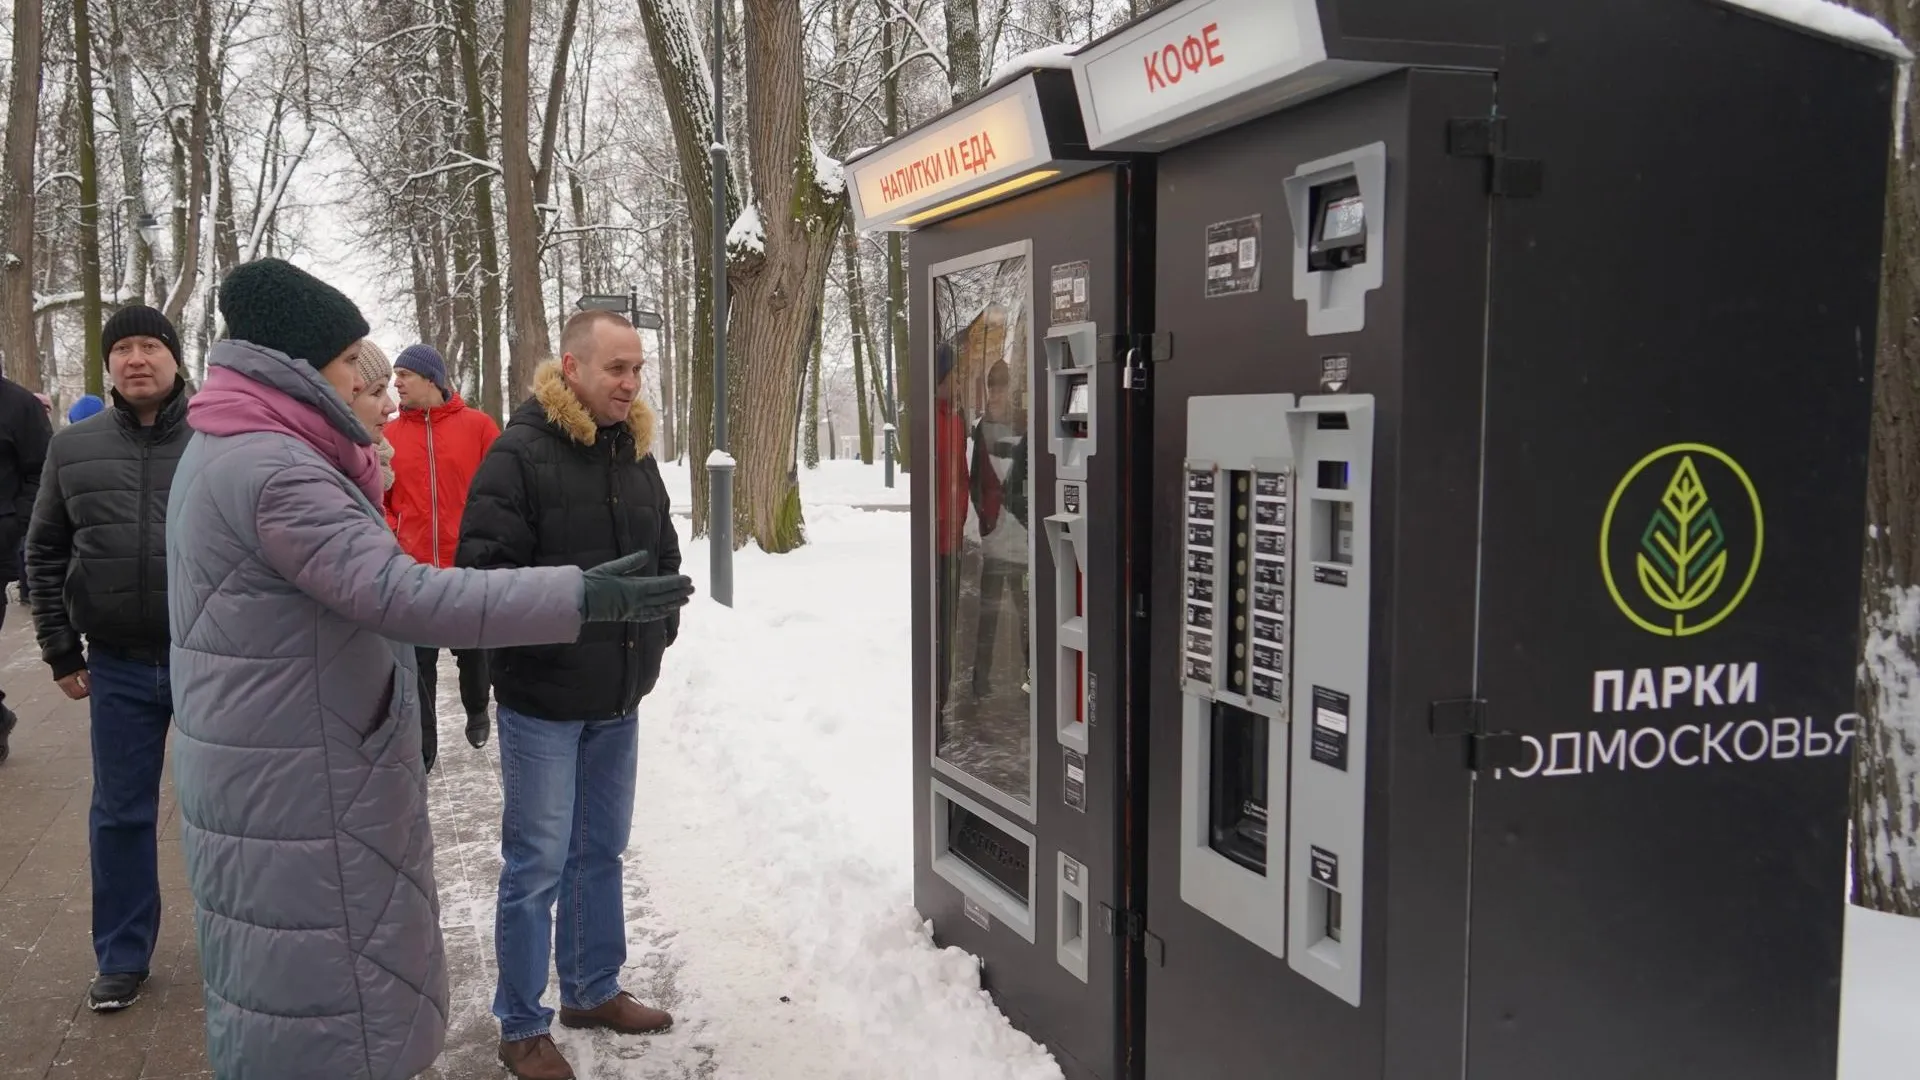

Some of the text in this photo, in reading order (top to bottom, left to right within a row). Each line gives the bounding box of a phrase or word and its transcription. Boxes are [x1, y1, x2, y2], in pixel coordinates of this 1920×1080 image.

[1144, 22, 1225, 93] КОФЕ
[880, 131, 996, 203] НАПИТКИ И ЕДА
[1592, 662, 1758, 713] ПАРКИ
[1472, 713, 1865, 780] ОДМОСКОВЬЯ
